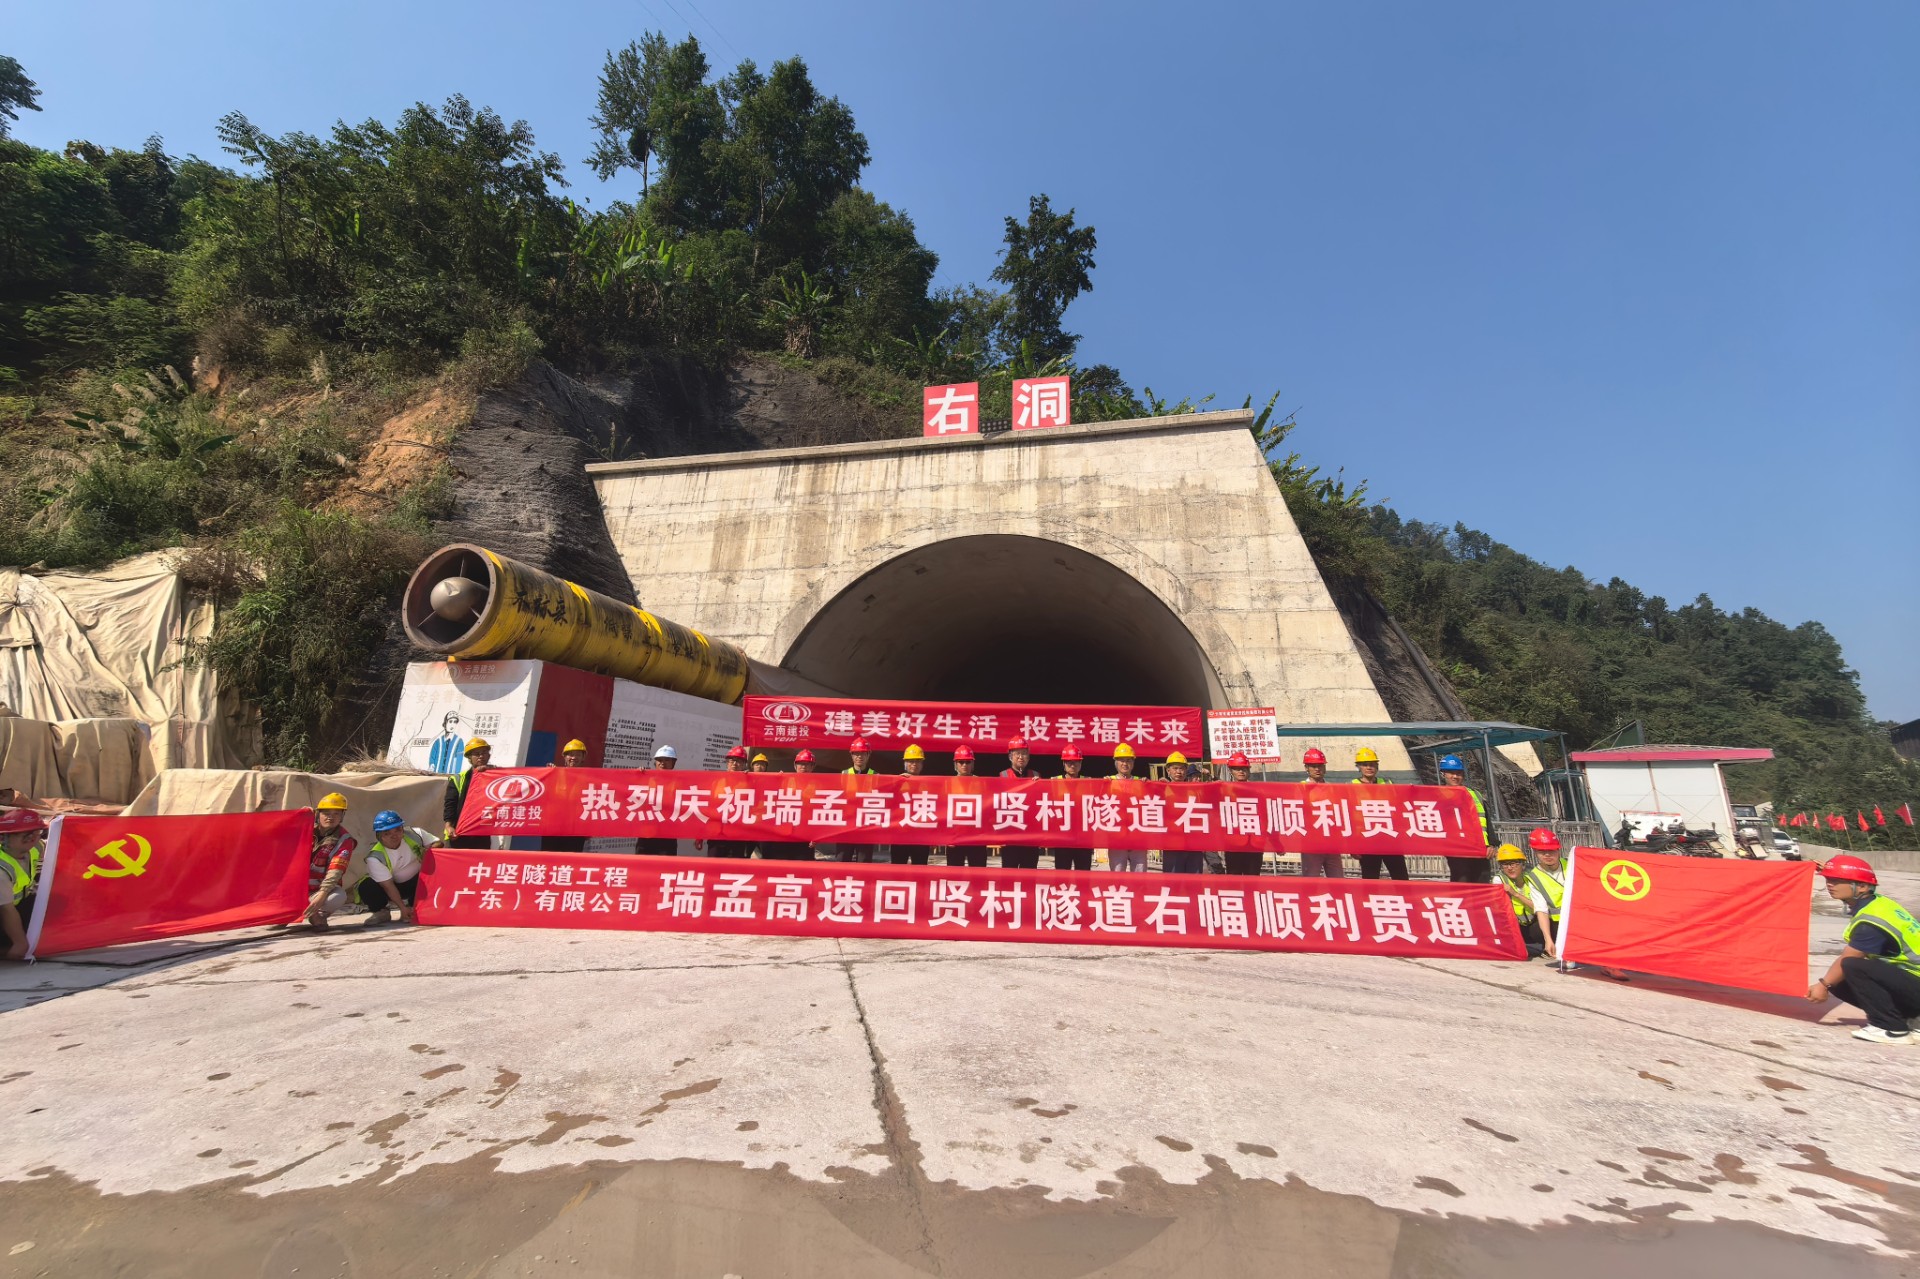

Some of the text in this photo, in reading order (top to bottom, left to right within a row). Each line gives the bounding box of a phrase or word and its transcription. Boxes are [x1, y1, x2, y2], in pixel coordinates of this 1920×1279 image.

[764, 725, 809, 737] 云南建投
[824, 710, 1189, 745] 建美好生活 投幸福未来
[481, 805, 542, 820] 云南建投
[580, 783, 1465, 839] 热烈庆祝瑞孟高速回贤村隧道右幅顺利贯通！
[468, 862, 628, 887] 中坚隧道工程
[433, 887, 640, 914] （广东）有限公司
[652, 870, 1501, 945] 瑞孟高速回贤村隧道右幅顺利贯通！
